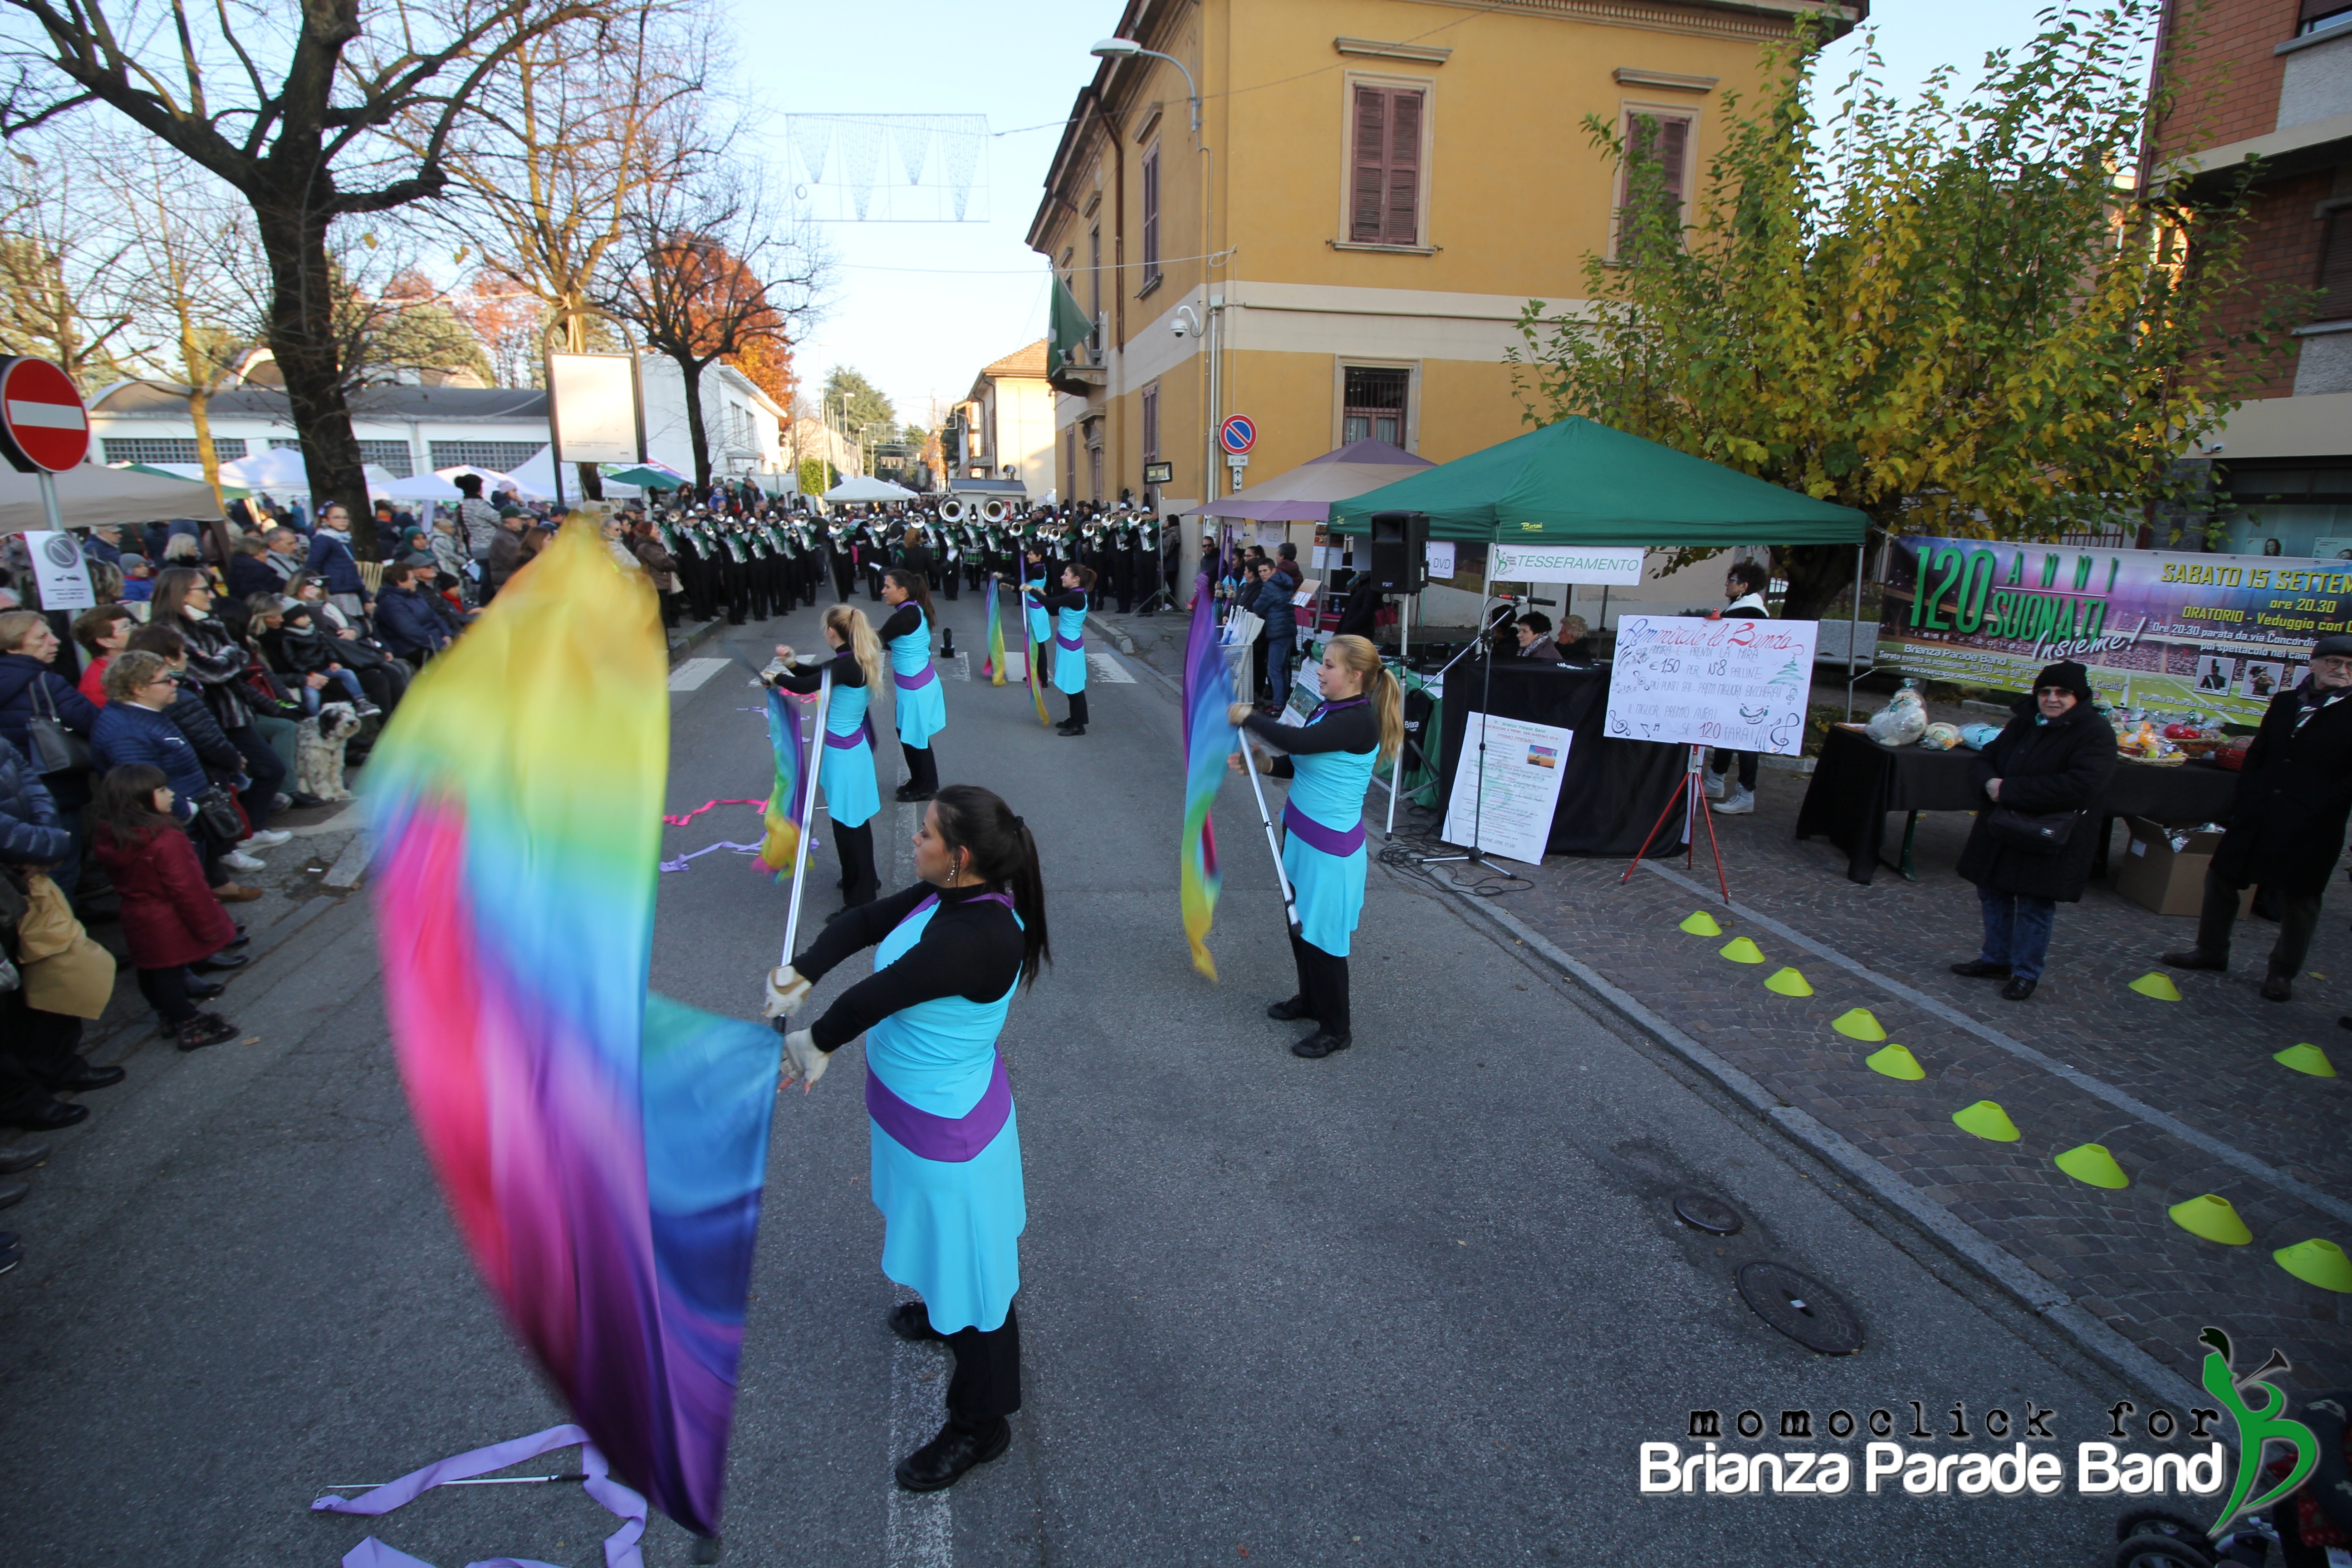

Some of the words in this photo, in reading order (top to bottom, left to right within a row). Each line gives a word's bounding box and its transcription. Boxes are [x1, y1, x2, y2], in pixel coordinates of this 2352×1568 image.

[1433, 557, 1451, 569] DVD
[1518, 554, 1639, 571] TESSERAMENTO
[2005, 550, 2118, 592] ANNI
[2161, 563, 2242, 587] SABATO
[2247, 568, 2270, 588] 15
[1910, 546, 1995, 633] 120
[2269, 599, 2293, 610] ore
[2295, 598, 2337, 613] 20.30
[1987, 591, 2107, 645] SUONATI
[2182, 606, 2245, 623] ORATORIO
[2257, 612, 2315, 631] Veduggio
[2317, 621, 2342, 632] con
[1727, 622, 1804, 656] Banda
[2032, 616, 2146, 661] Insieme!
[2152, 622, 2169, 633] Ore
[2171, 624, 2200, 636] 20:30
[2200, 628, 2233, 640] parata
[2234, 631, 2247, 641] da
[2249, 633, 2265, 642] via
[1719, 648, 1730, 658] LA
[1737, 648, 1759, 662] MIRA
[1878, 650, 1901, 660] Serata
[1901, 654, 1924, 664] evento
[1932, 657, 1966, 669] occasione
[1904, 644, 1941, 657] Brianza
[1943, 649, 1978, 662] Parade
[1980, 654, 2008, 666] Band
[2200, 642, 2216, 652] poi
[2216, 643, 2270, 657] spettacolo
[2270, 649, 2287, 659] nel
[1686, 663, 1702, 678] PER
[1730, 666, 1762, 680] PALLINE
[1661, 681, 1679, 691] PUNTI
[1716, 682, 1743, 700] MIGLIORI
[1744, 684, 1782, 701] BECCHERAI
[1627, 703, 1632, 714] IL
[1635, 702, 1659, 718] MIGLIOR
[1664, 705, 1690, 719] PREMIO
[1693, 706, 1717, 721] AVRAI
[2138, 692, 2166, 704] Durante
[2175, 699, 2197, 708] serata
[2198, 701, 2206, 709] si
[2207, 703, 2243, 715] esibiranno
[1497, 733, 1514, 741] PRIMO
[1514, 735, 1535, 744] PREMIO
[1531, 732, 1549, 740] MARTINO
[1698, 721, 1721, 740] 120
